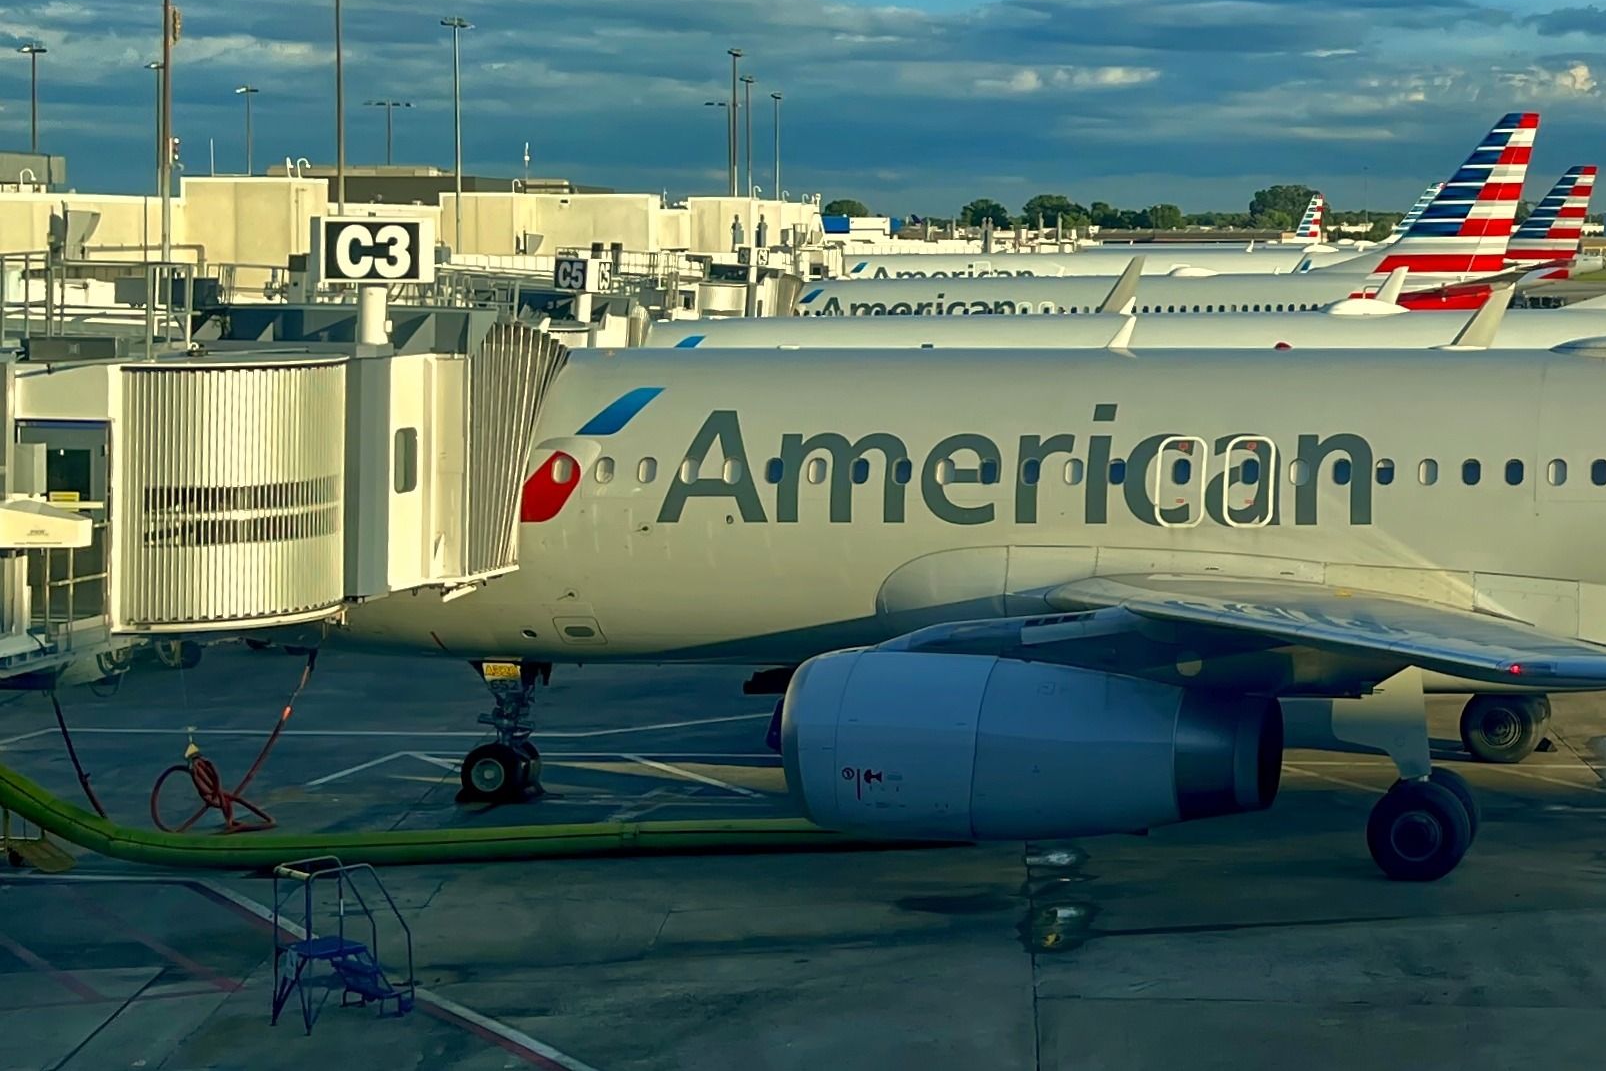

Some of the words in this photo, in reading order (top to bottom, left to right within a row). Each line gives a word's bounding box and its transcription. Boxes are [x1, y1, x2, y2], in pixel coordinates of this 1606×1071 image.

[336, 224, 411, 278] C3
[558, 262, 583, 288] C5
[598, 262, 611, 290] C5
[656, 404, 1375, 526] American
